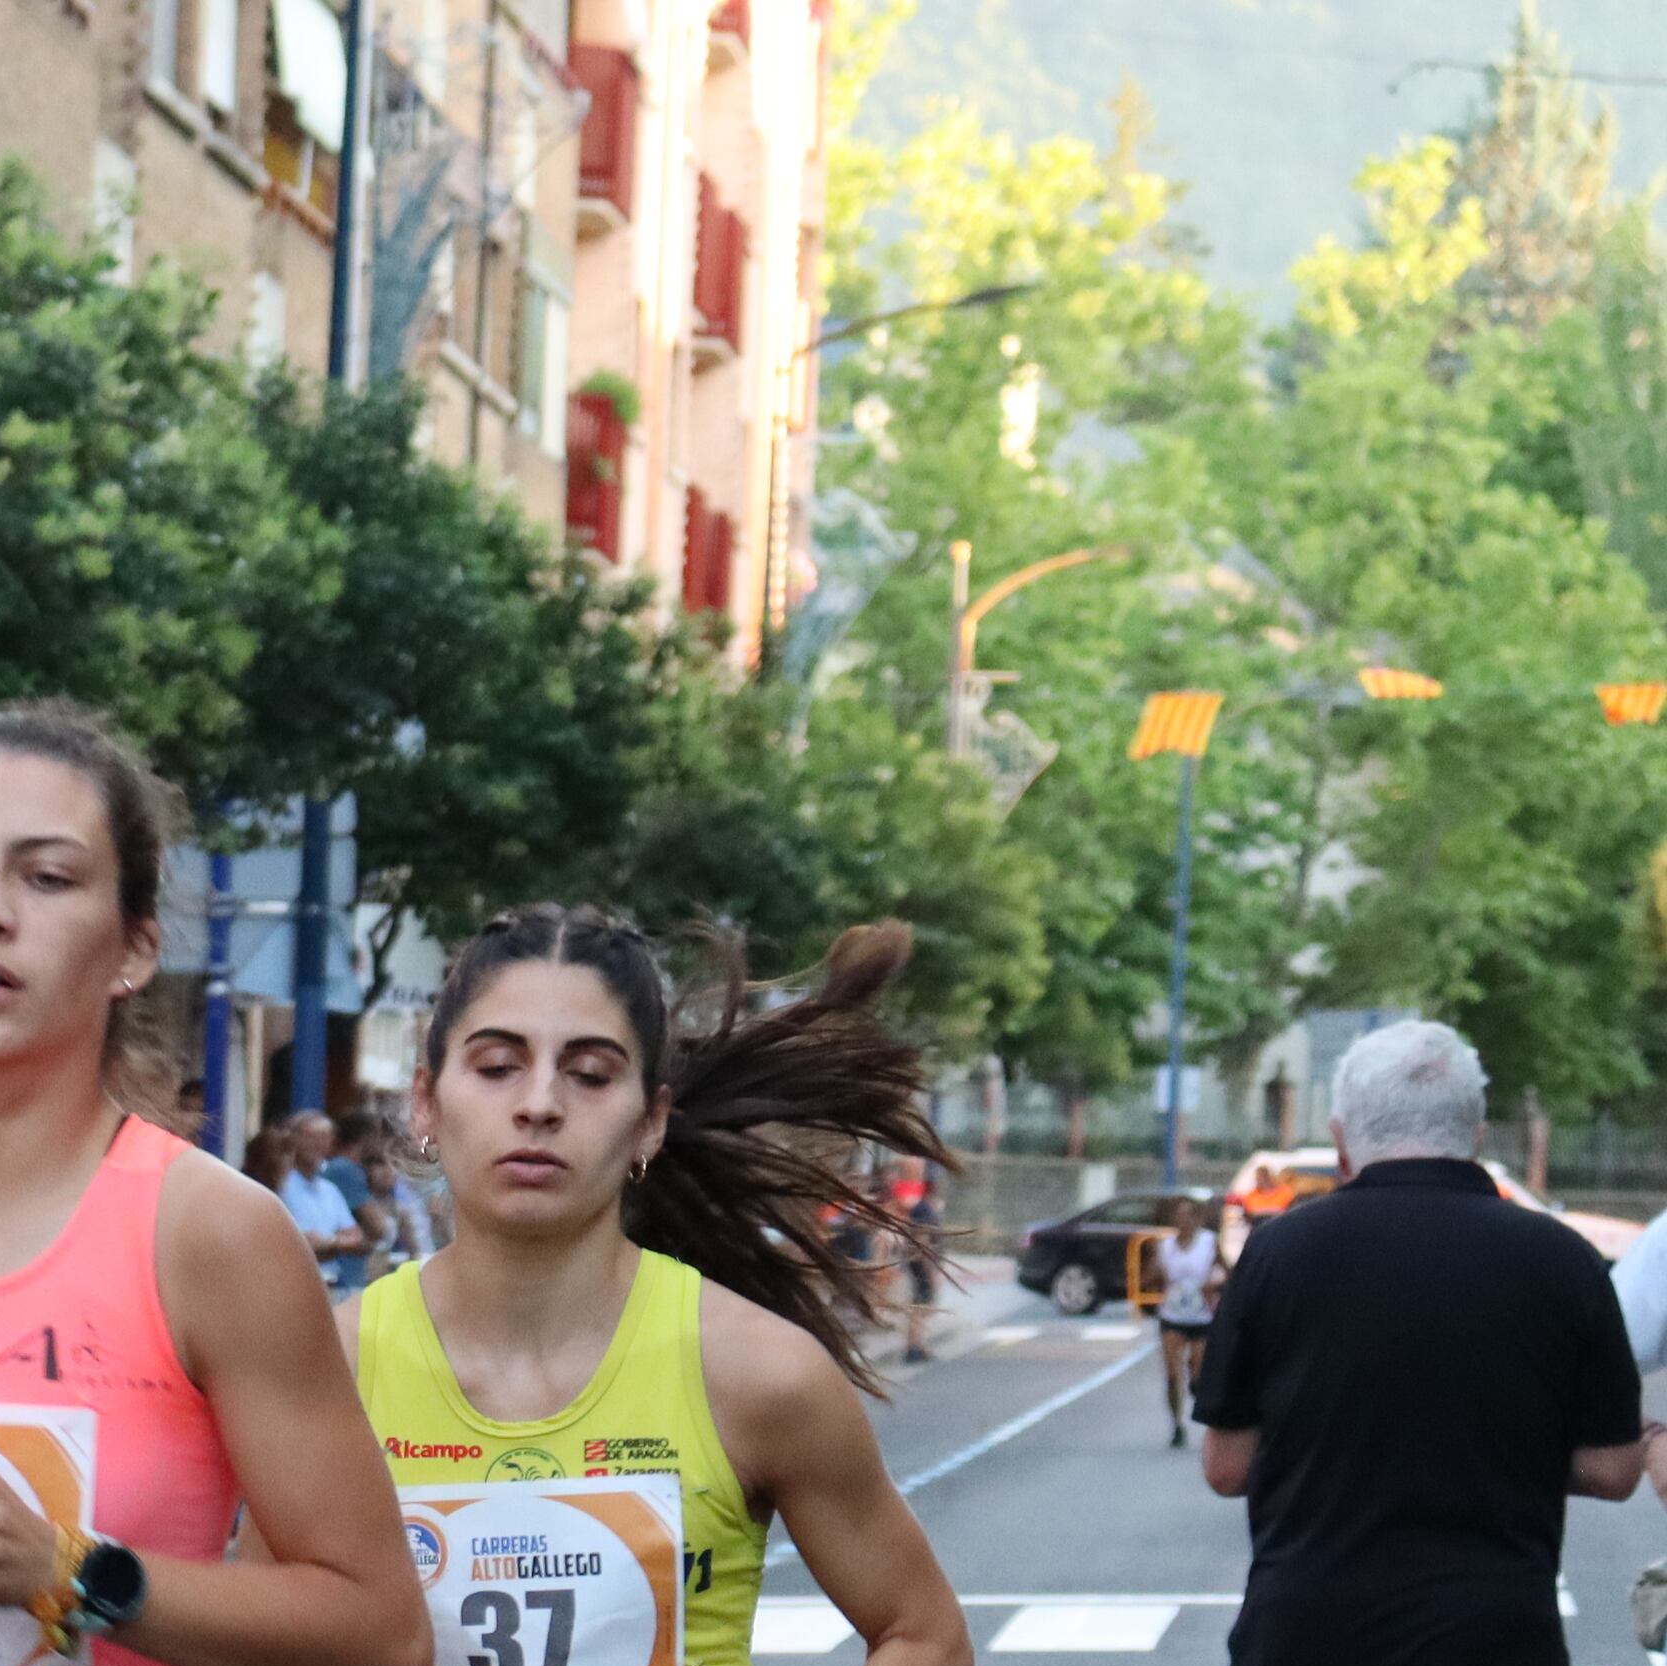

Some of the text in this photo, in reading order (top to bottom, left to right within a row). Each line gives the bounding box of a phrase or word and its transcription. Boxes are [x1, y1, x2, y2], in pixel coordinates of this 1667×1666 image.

[384, 1437, 483, 1463] Alcampo
[607, 1438, 669, 1450] GOBIERNO
[471, 1535, 548, 1556] CARRERAS
